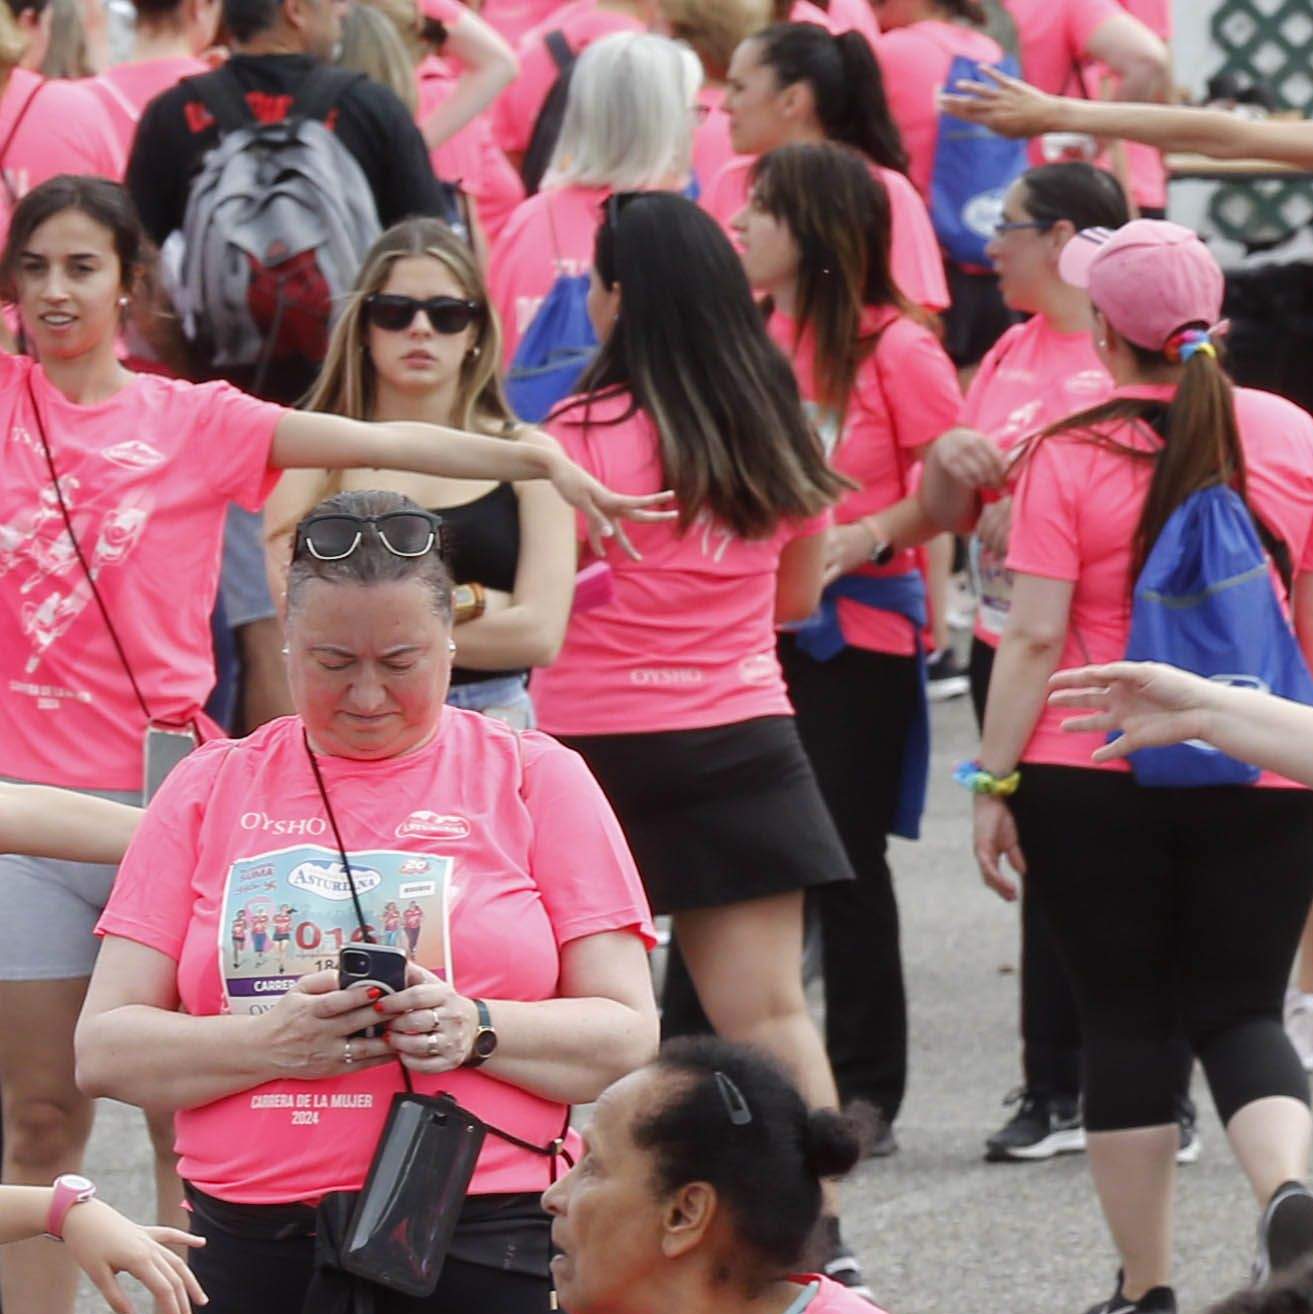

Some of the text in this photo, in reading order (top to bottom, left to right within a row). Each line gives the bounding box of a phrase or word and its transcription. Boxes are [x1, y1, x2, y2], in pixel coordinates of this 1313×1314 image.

[240, 812, 327, 836] OYSHO
[313, 1094, 329, 1108] LA
[330, 1094, 373, 1108] MUJER
[291, 1110, 320, 1125] 2024
